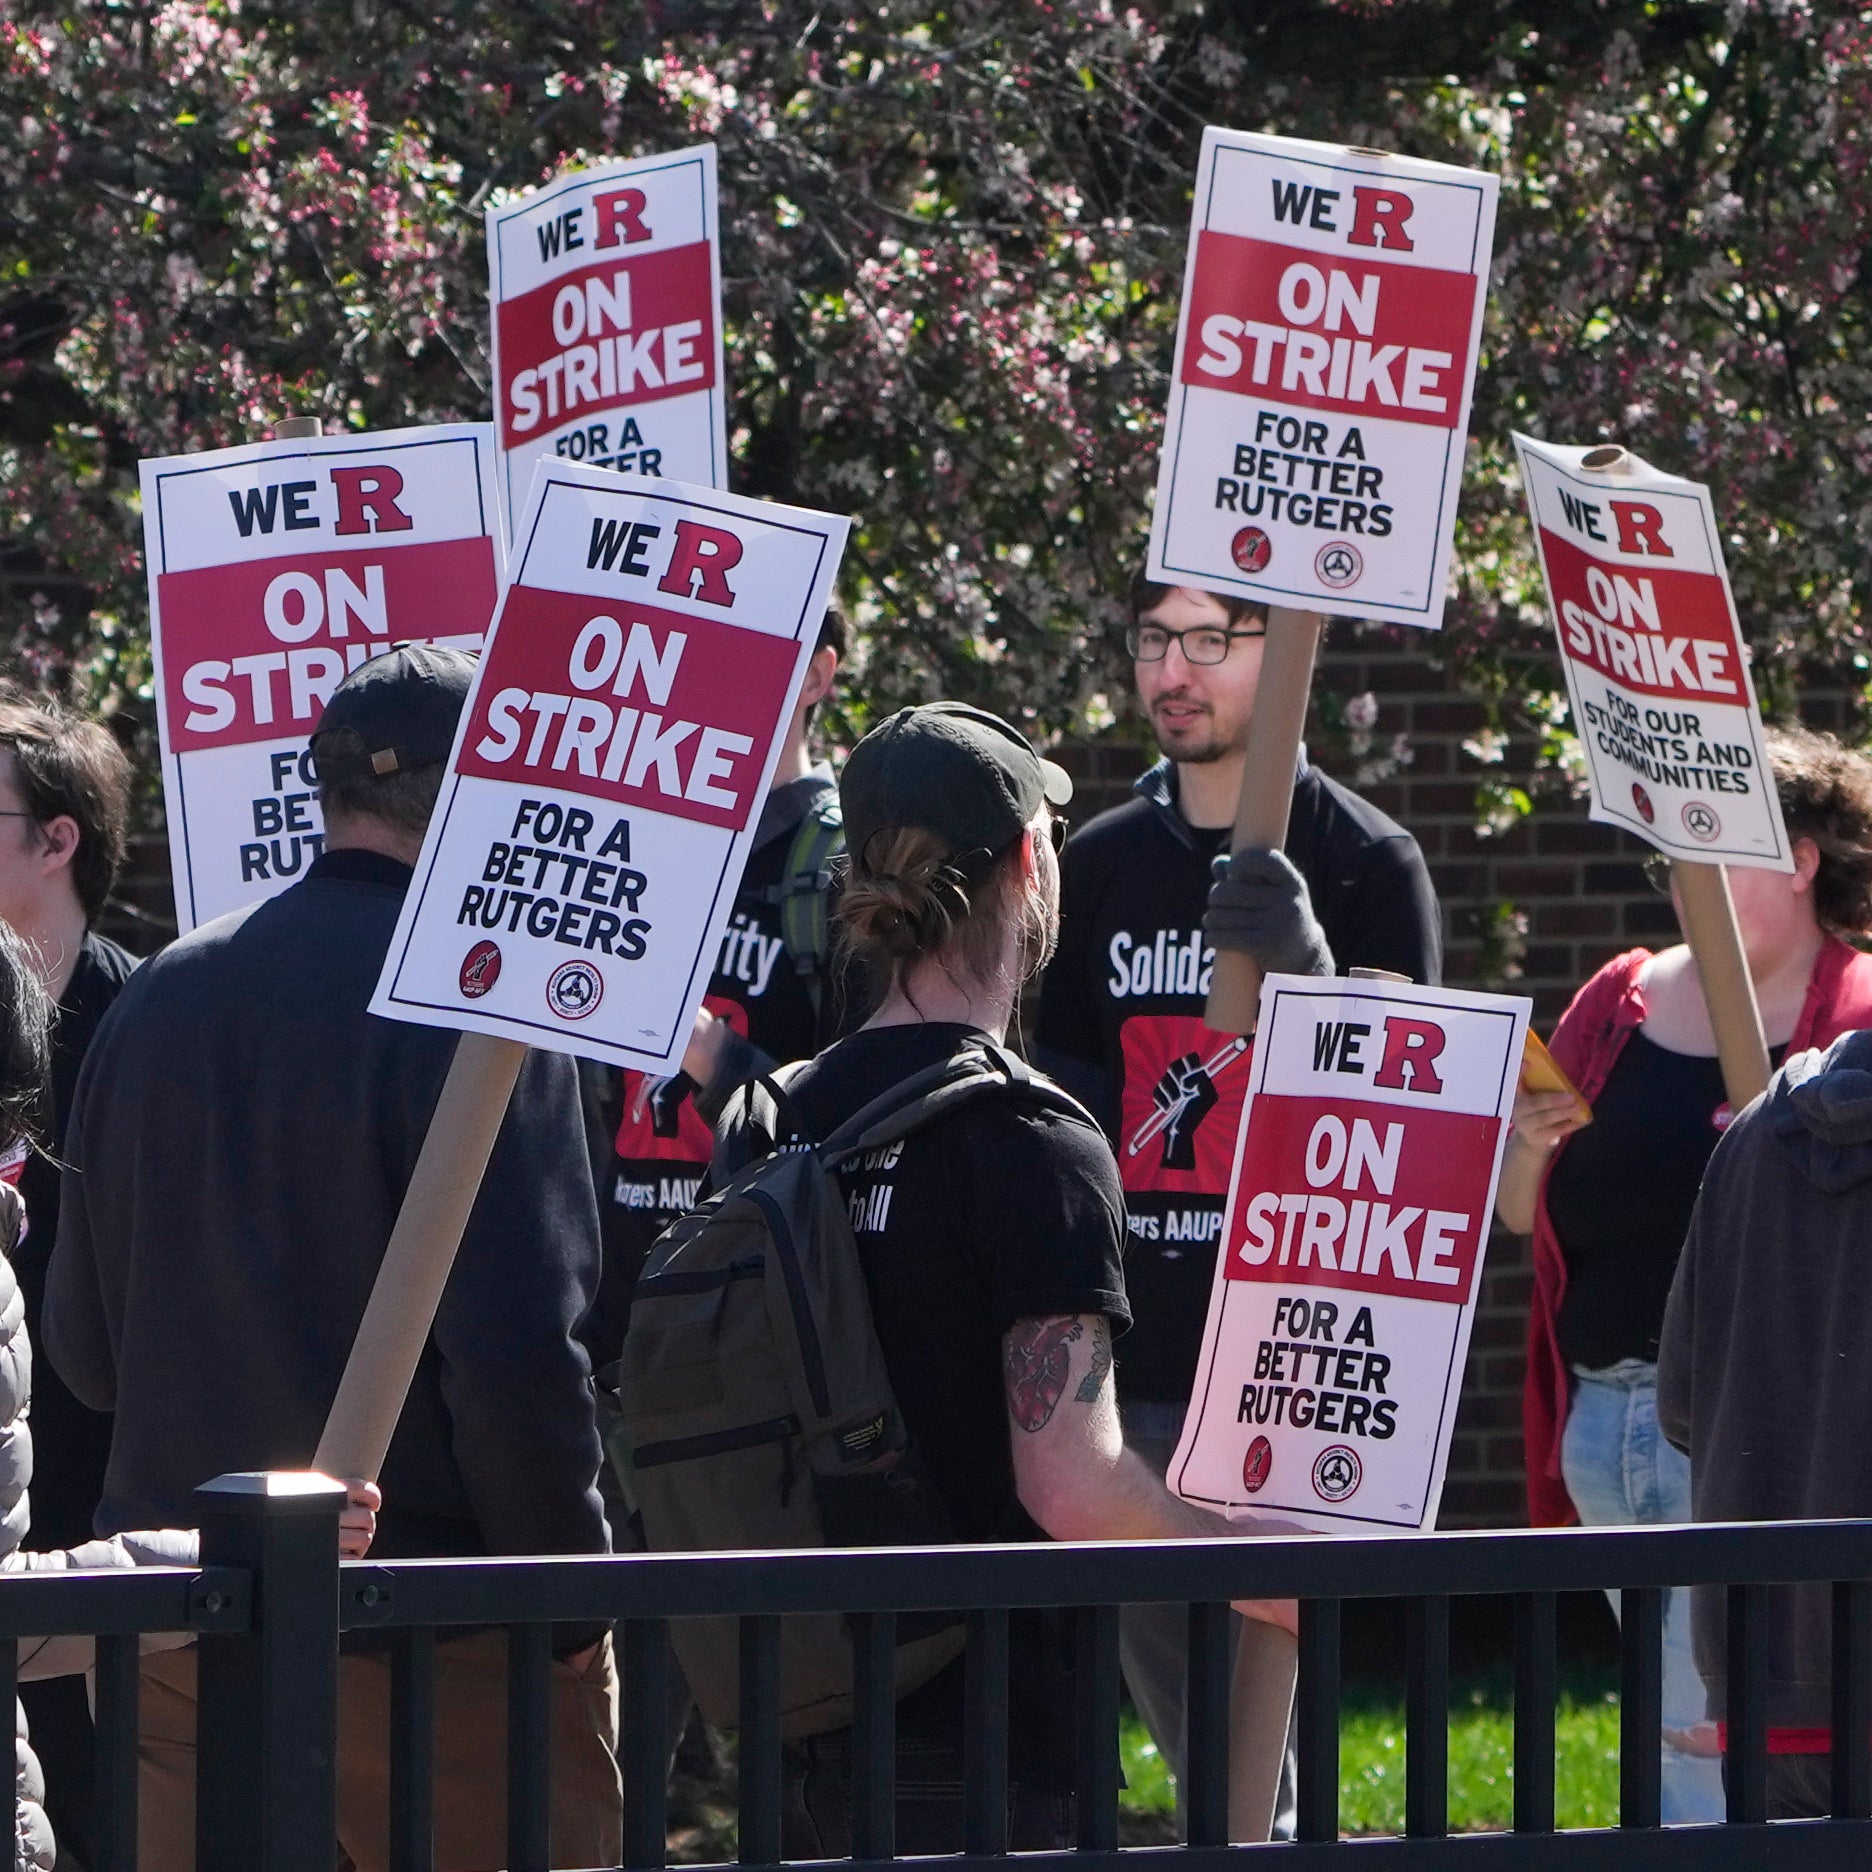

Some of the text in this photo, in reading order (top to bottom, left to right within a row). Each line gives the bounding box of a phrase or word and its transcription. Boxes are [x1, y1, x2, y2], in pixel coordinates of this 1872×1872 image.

[537, 188, 652, 264] WE R
[1272, 179, 1415, 252] WE R
[552, 270, 632, 347] ON
[1278, 261, 1380, 337] ON
[509, 319, 705, 432] STRIKE
[1196, 314, 1452, 413] STRIKE
[555, 417, 644, 461] FOR A
[1233, 444, 1384, 499] BETTER
[1255, 411, 1366, 460] FOR A
[228, 464, 413, 537] WE R
[1214, 477, 1394, 537] RUTGERS
[1557, 486, 1675, 558] WE R
[586, 517, 745, 608] WE R
[1585, 565, 1661, 631] ON
[263, 565, 388, 643] ON
[182, 633, 483, 733] STR
[568, 615, 688, 707] ON
[1561, 599, 1738, 695] STRIKE
[475, 687, 755, 811] STRIKE
[1584, 701, 1753, 769] STUDENTS AND
[1606, 688, 1702, 737] FOR OUR
[1597, 731, 1750, 795] COMMUNITIES
[510, 799, 631, 863] FOR A
[482, 842, 648, 913] BETTER
[456, 885, 652, 960] RUTGERS
[1312, 1015, 1447, 1094] WE R
[1304, 1113, 1406, 1196] ON
[864, 1184, 894, 1232] All
[1238, 1191, 1470, 1286] STRIKE
[1272, 1297, 1376, 1348] FOR A
[1253, 1341, 1392, 1394] BETTER
[1237, 1383, 1399, 1440] RUTGERS
